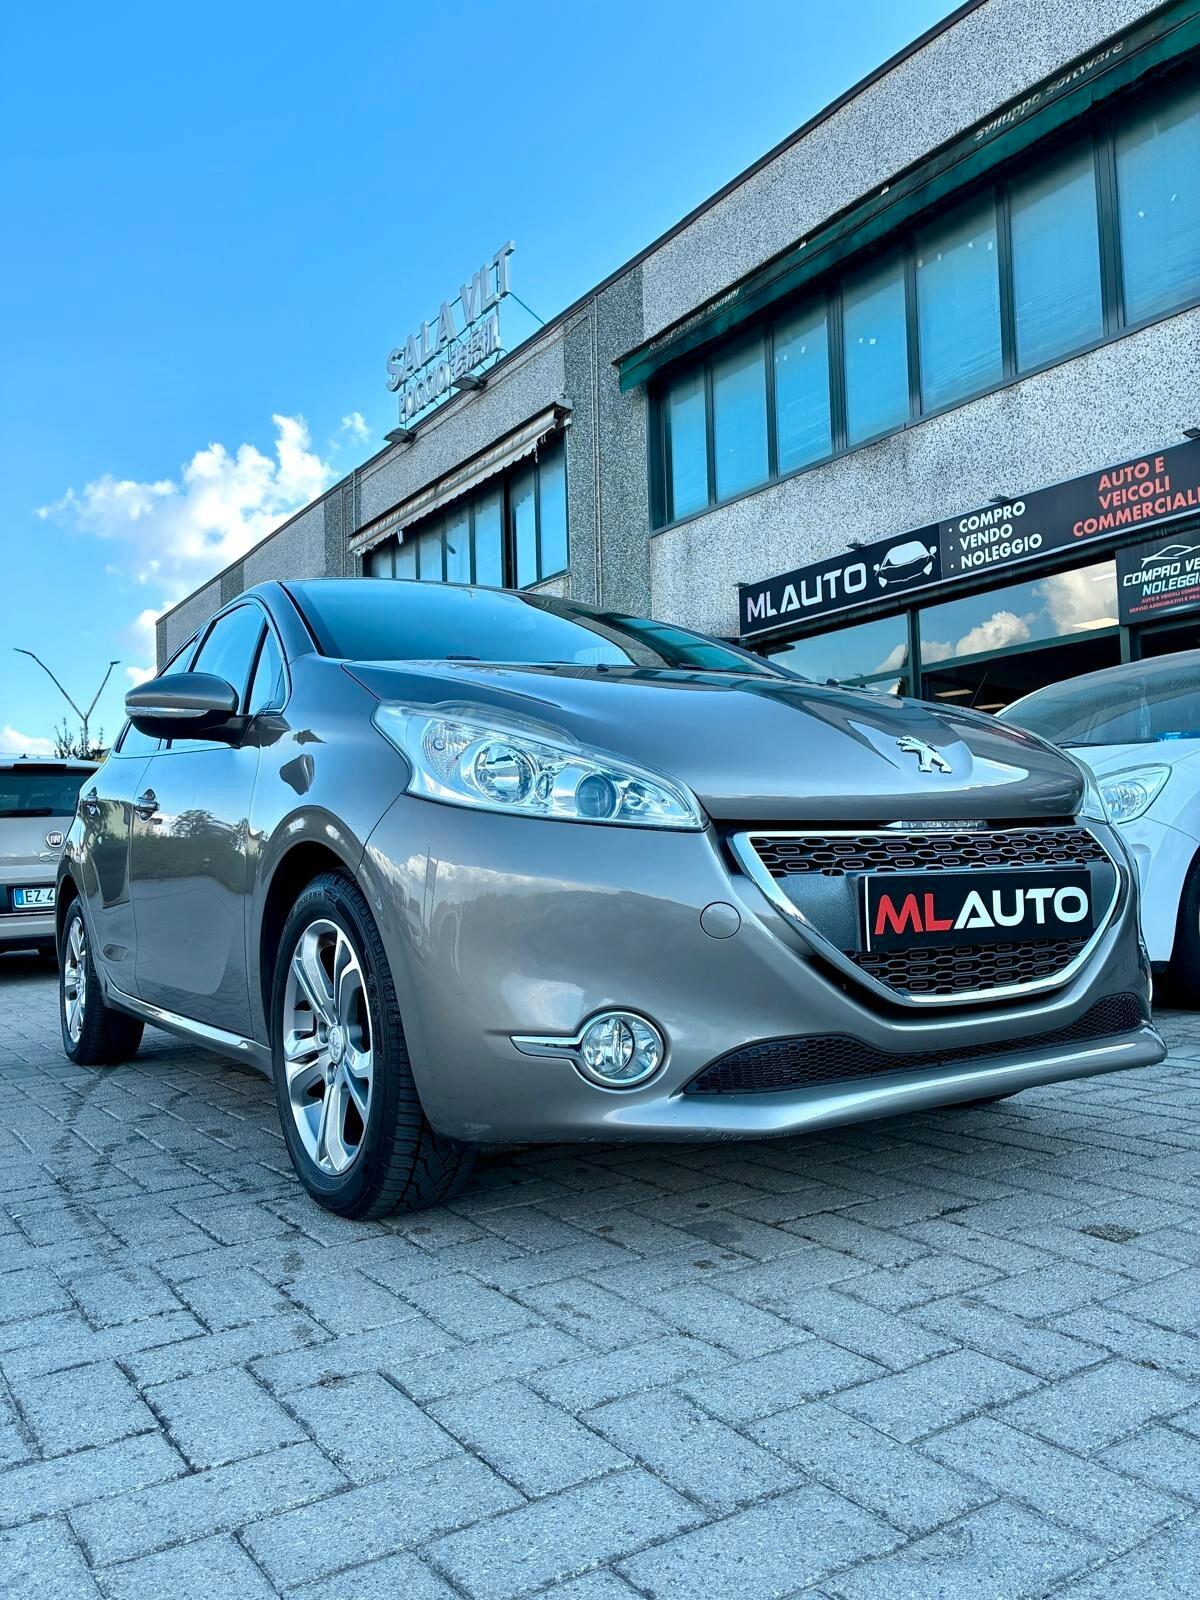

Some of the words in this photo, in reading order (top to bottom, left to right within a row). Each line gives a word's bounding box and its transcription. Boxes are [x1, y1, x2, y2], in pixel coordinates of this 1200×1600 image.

[386, 302, 457, 392] SALA
[460, 240, 516, 327] VLT
[399, 361, 451, 424] POGGIO
[1098, 462, 1150, 491] AUTO
[1154, 456, 1165, 473] E
[1098, 475, 1170, 509] VEICOLI
[959, 501, 1026, 533] COMPRO
[960, 523, 1013, 551] VENDO
[960, 533, 1043, 570] NOLEGGIO
[1123, 562, 1181, 587] COMPRO
[1142, 571, 1200, 596] NOLEGGI
[25, 890, 41, 902] EZ
